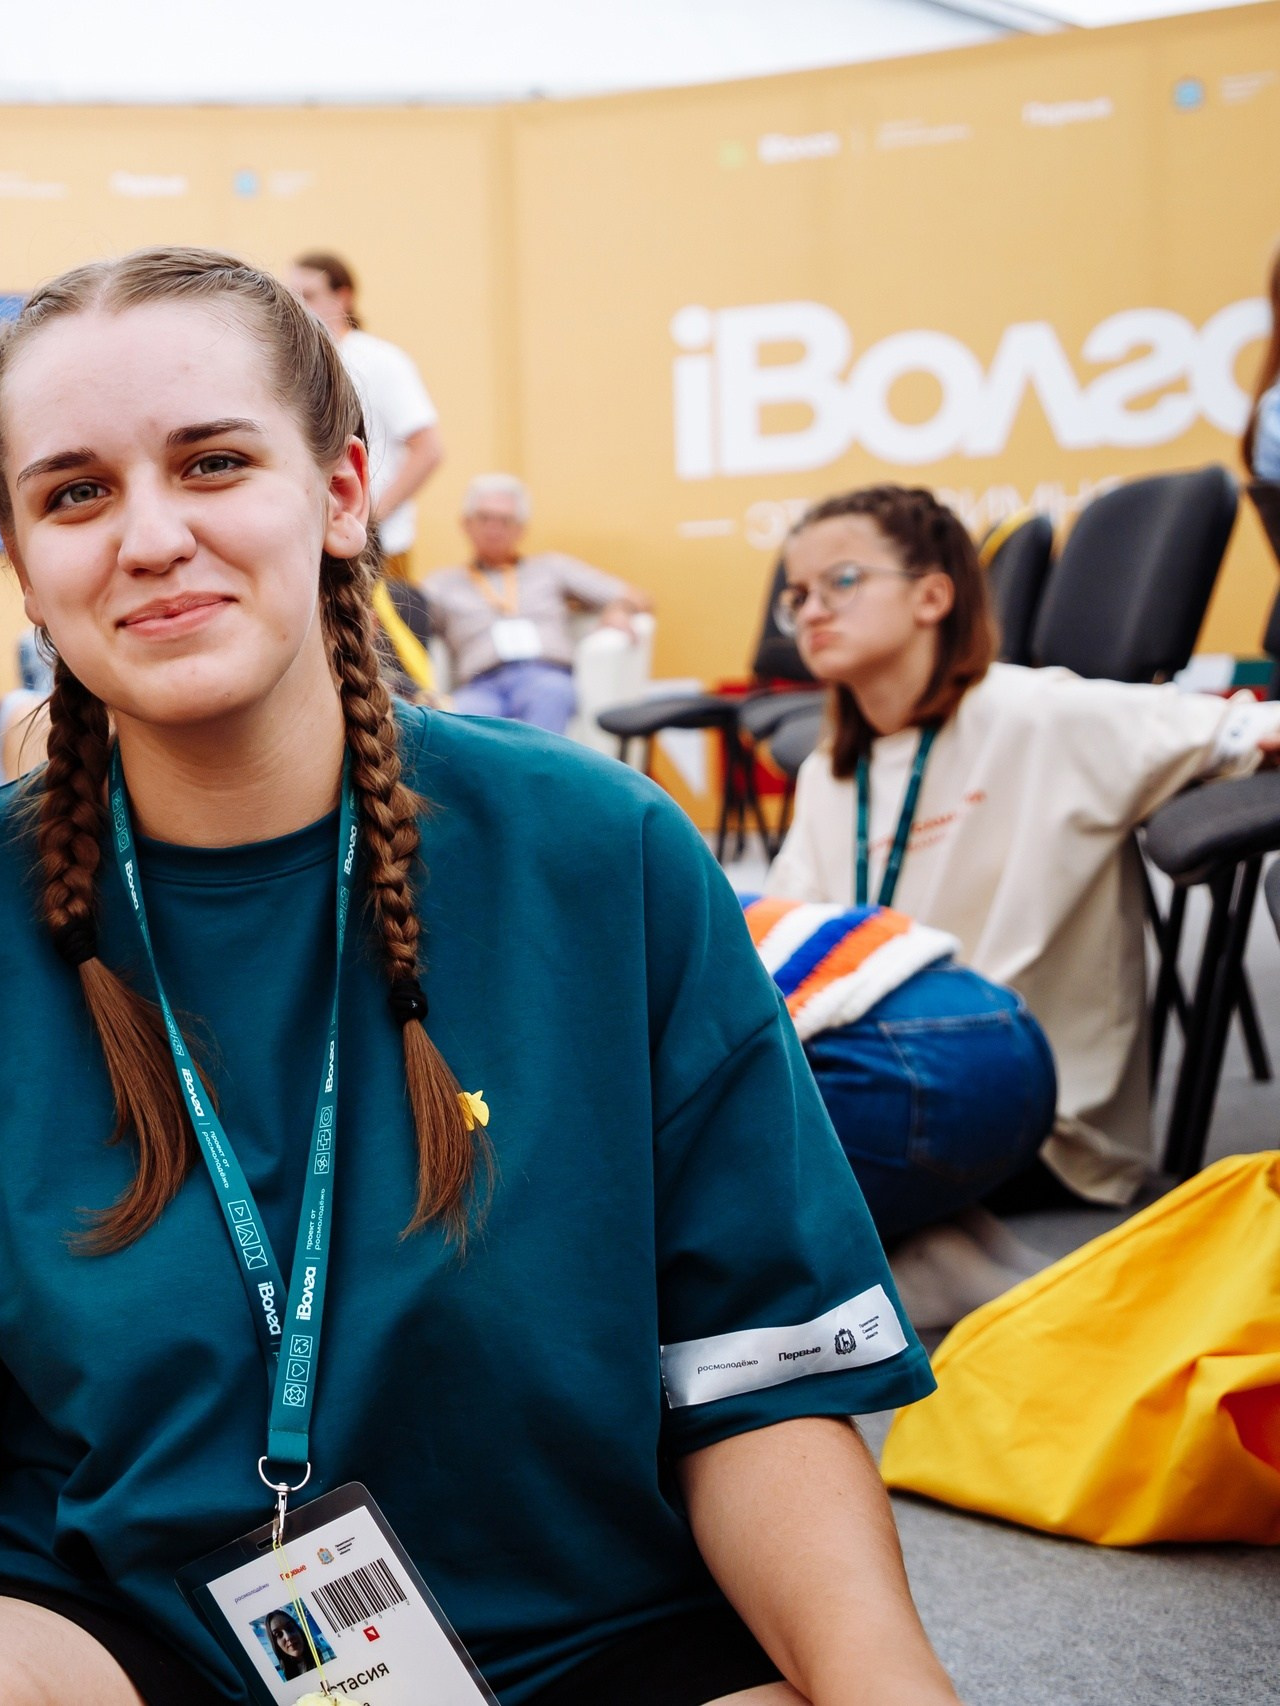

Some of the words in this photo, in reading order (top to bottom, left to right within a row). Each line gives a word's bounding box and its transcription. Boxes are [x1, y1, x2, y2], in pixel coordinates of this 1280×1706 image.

[324, 1039, 335, 1094] iВолга
[181, 1067, 206, 1118] iВолга
[210, 1130, 226, 1157] проект
[306, 1221, 315, 1251] проект
[257, 1280, 282, 1336] iВолга
[295, 1265, 317, 1321] iВолга
[697, 1358, 759, 1374] росмолодёжь
[778, 1346, 822, 1362] Первые
